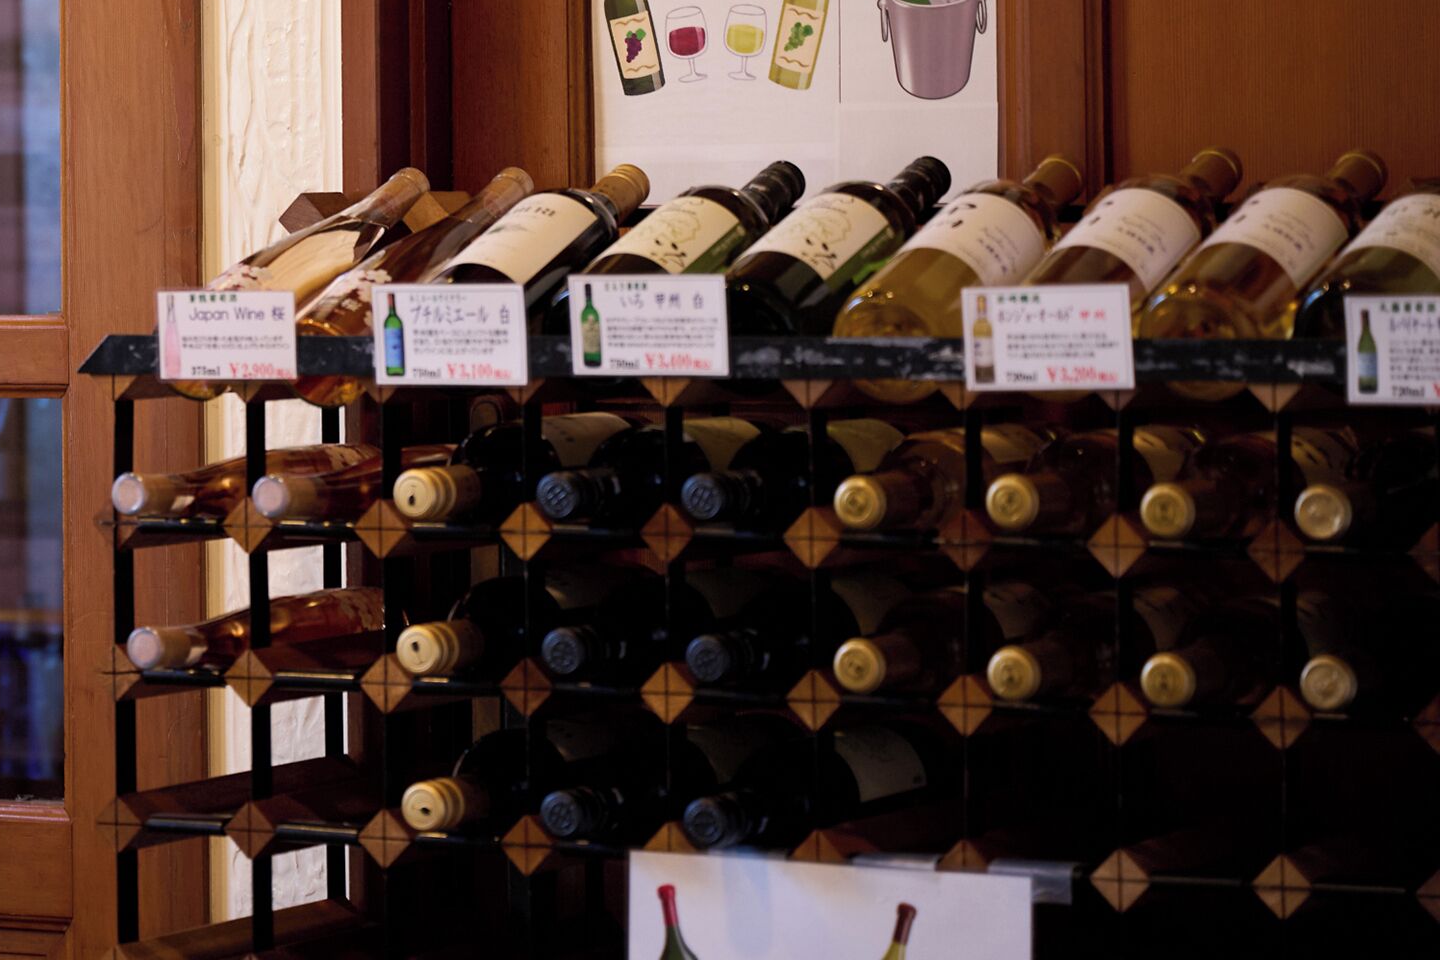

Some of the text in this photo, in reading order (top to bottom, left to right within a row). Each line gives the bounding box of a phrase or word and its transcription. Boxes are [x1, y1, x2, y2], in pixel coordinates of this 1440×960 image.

[189, 306, 286, 322] Japan Wine 桜
